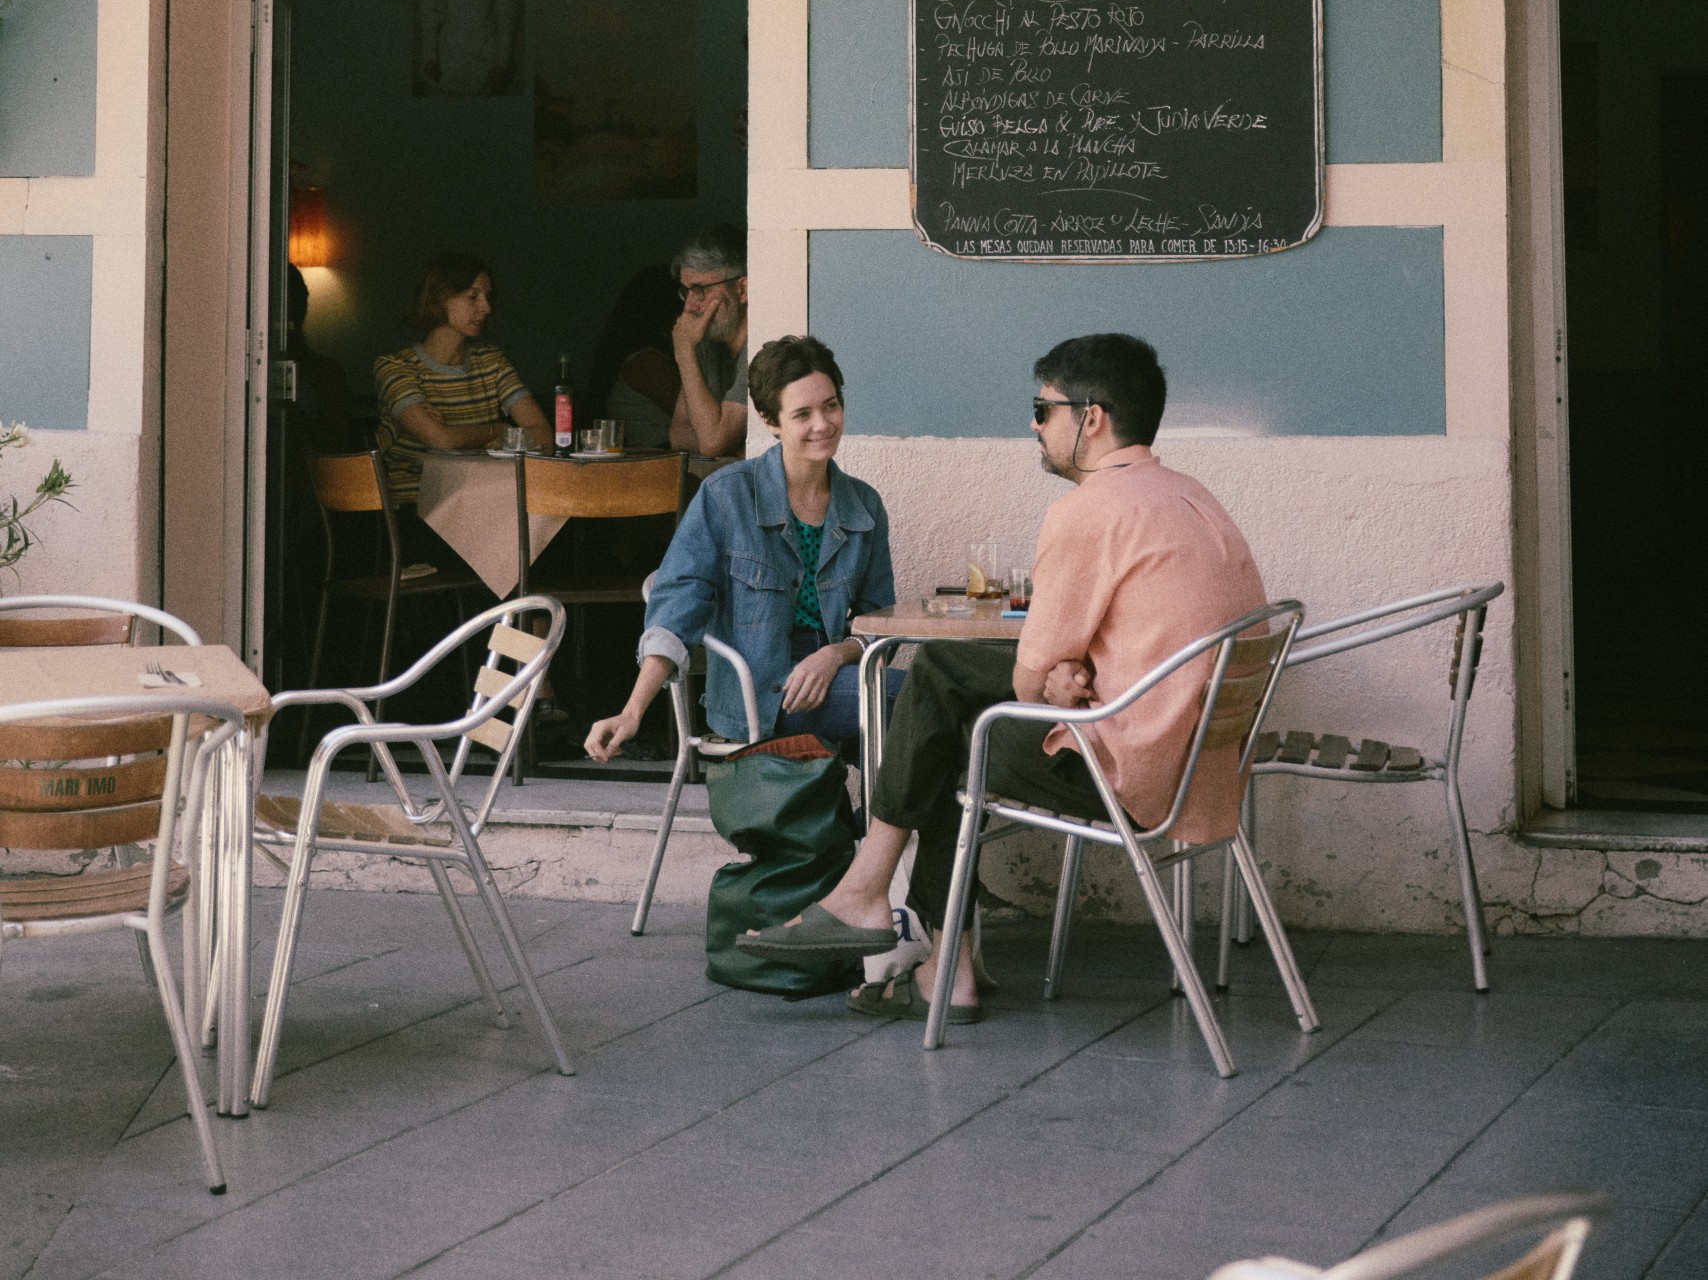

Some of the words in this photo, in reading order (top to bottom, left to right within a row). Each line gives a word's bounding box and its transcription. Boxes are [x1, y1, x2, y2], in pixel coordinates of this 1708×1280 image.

[1019, 10, 1039, 27] AL
[1049, 3, 1101, 30] PESTO
[935, 33, 1004, 62] PECHUGA
[1009, 41, 1032, 58] DE
[1036, 29, 1079, 56] POLLO
[976, 67, 1003, 84] DE
[1009, 58, 1051, 85] POLLO
[1044, 91, 1067, 109] DE
[1071, 83, 1130, 107] CARNE
[1055, 110, 1072, 133] &
[1204, 99, 1267, 131] VERDE
[1026, 140, 1037, 152] A
[1043, 139, 1059, 155] LA
[1067, 133, 1135, 158] PLANCHA
[1043, 160, 1075, 181] EN
[940, 201, 990, 232] PANNA
[994, 207, 1037, 236] COTTA
[1125, 208, 1180, 234] LECHE
[956, 240, 976, 254] LAS
[980, 240, 1012, 254] MESAS
[1017, 239, 1054, 254] QUEDAN
[1061, 239, 1123, 254] RESERVADAS
[1129, 239, 1155, 254] PARA
[1161, 239, 1197, 253] COMER
[1204, 239, 1217, 253] DE
